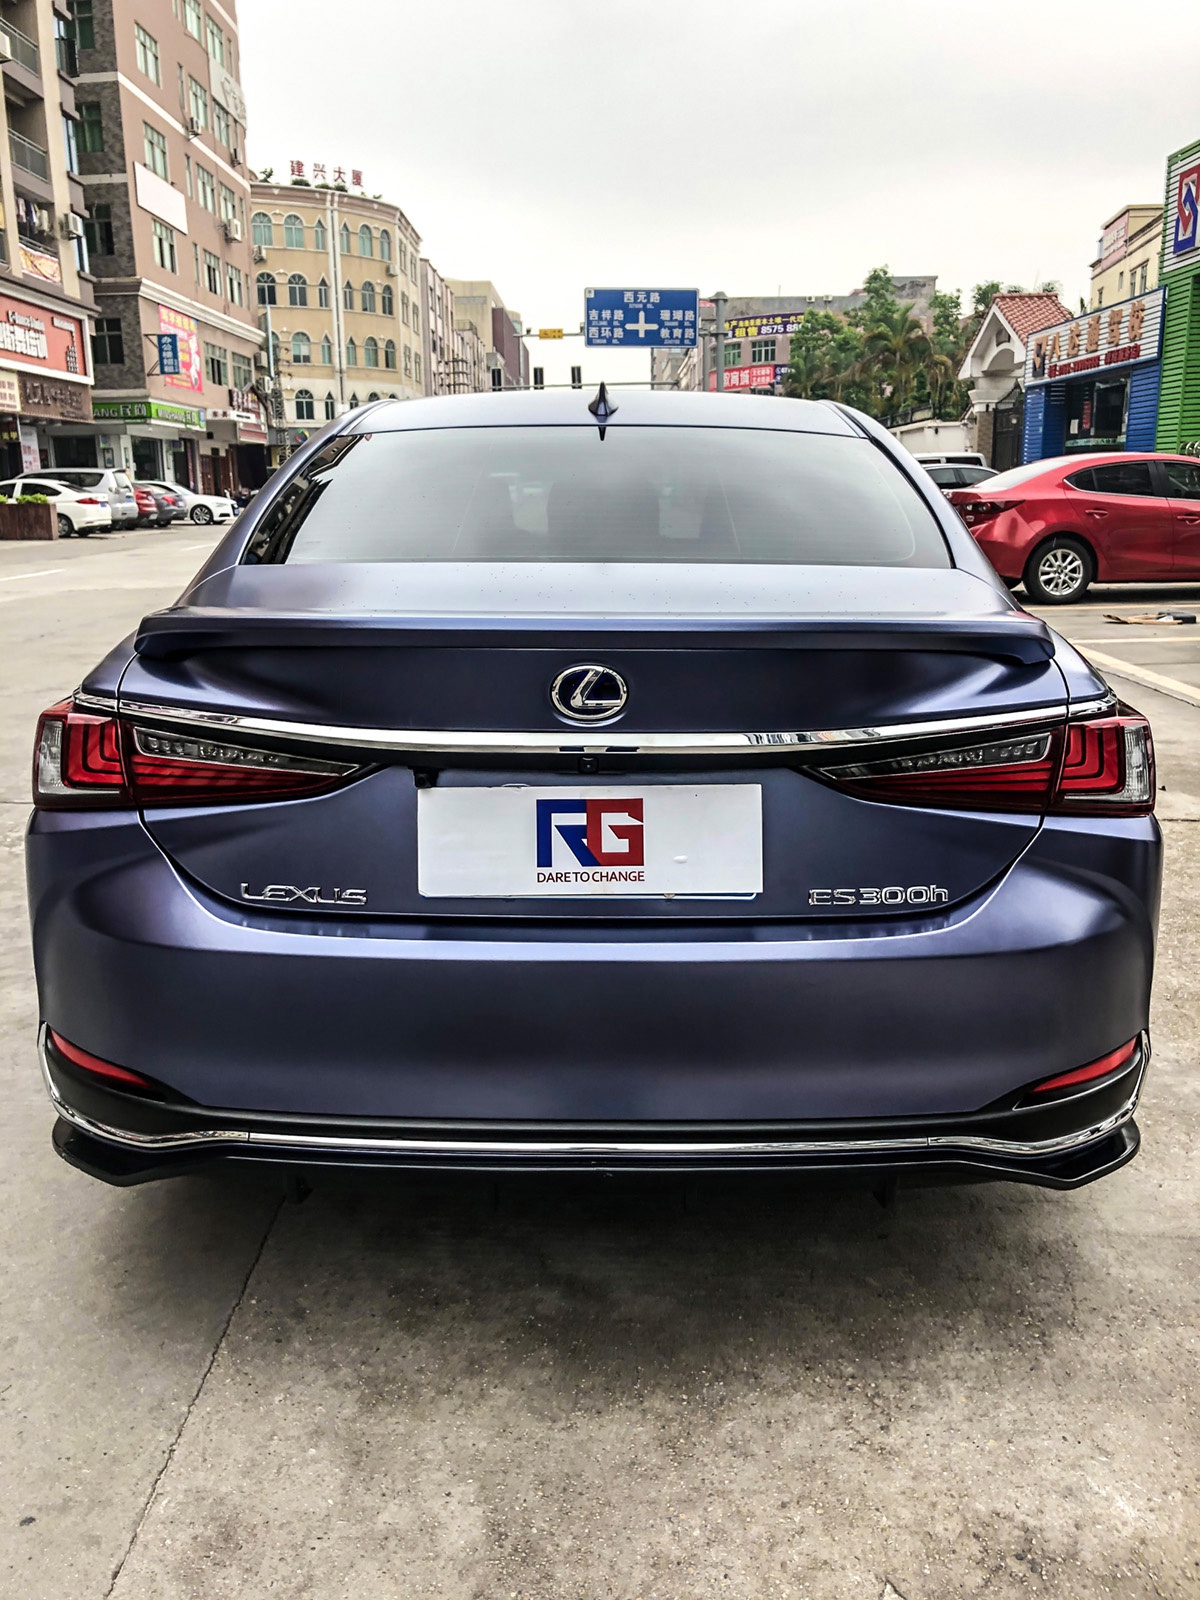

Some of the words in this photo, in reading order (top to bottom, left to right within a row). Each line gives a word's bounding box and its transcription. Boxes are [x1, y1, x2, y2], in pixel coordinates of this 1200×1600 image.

[290, 160, 363, 187] 建兴大厦
[623, 291, 660, 303] 西元路
[588, 309, 624, 321] 吉祥路
[588, 327, 624, 338] 西环路
[660, 327, 695, 339] 教育路
[761, 324, 784, 335] 8575
[1048, 299, 1145, 362] 八达通驾校
[536, 798, 644, 867] RG
[537, 871, 571, 882] DARE
[572, 871, 590, 882] TO
[591, 870, 645, 882] CHANGE
[240, 882, 367, 905] LEXUS
